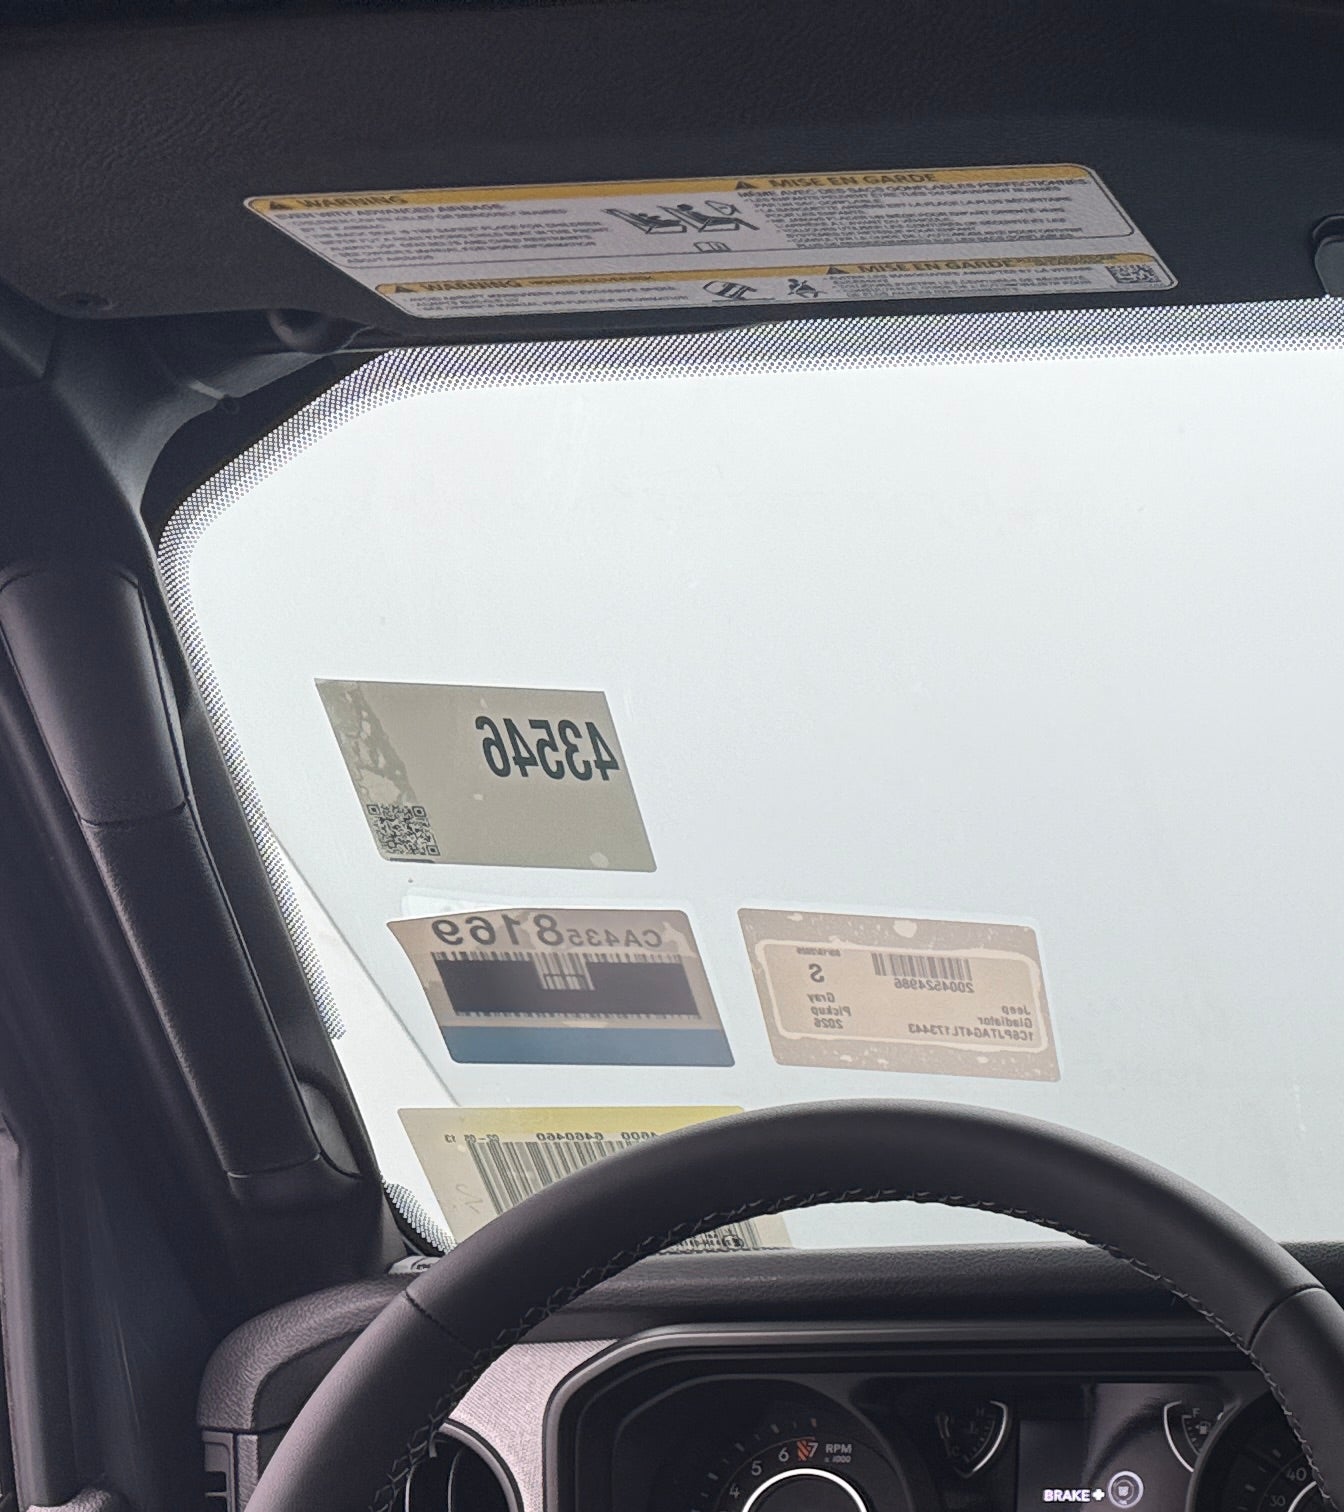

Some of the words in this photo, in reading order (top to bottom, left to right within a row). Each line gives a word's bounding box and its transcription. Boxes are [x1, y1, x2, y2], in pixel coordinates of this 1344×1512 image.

[769, 178, 822, 189] MISE
[828, 176, 857, 186] EN
[863, 173, 937, 185] GARDE
[299, 196, 407, 209] WARNING
[778, 1447, 789, 1462] 6
[825, 1443, 852, 1455] RPM
[751, 1460, 763, 1476] 5
[1286, 1467, 1307, 1482] 40
[729, 1484, 741, 1499] 4
[1043, 1489, 1091, 1502] BRAKE
[1269, 1495, 1287, 1508] 30
